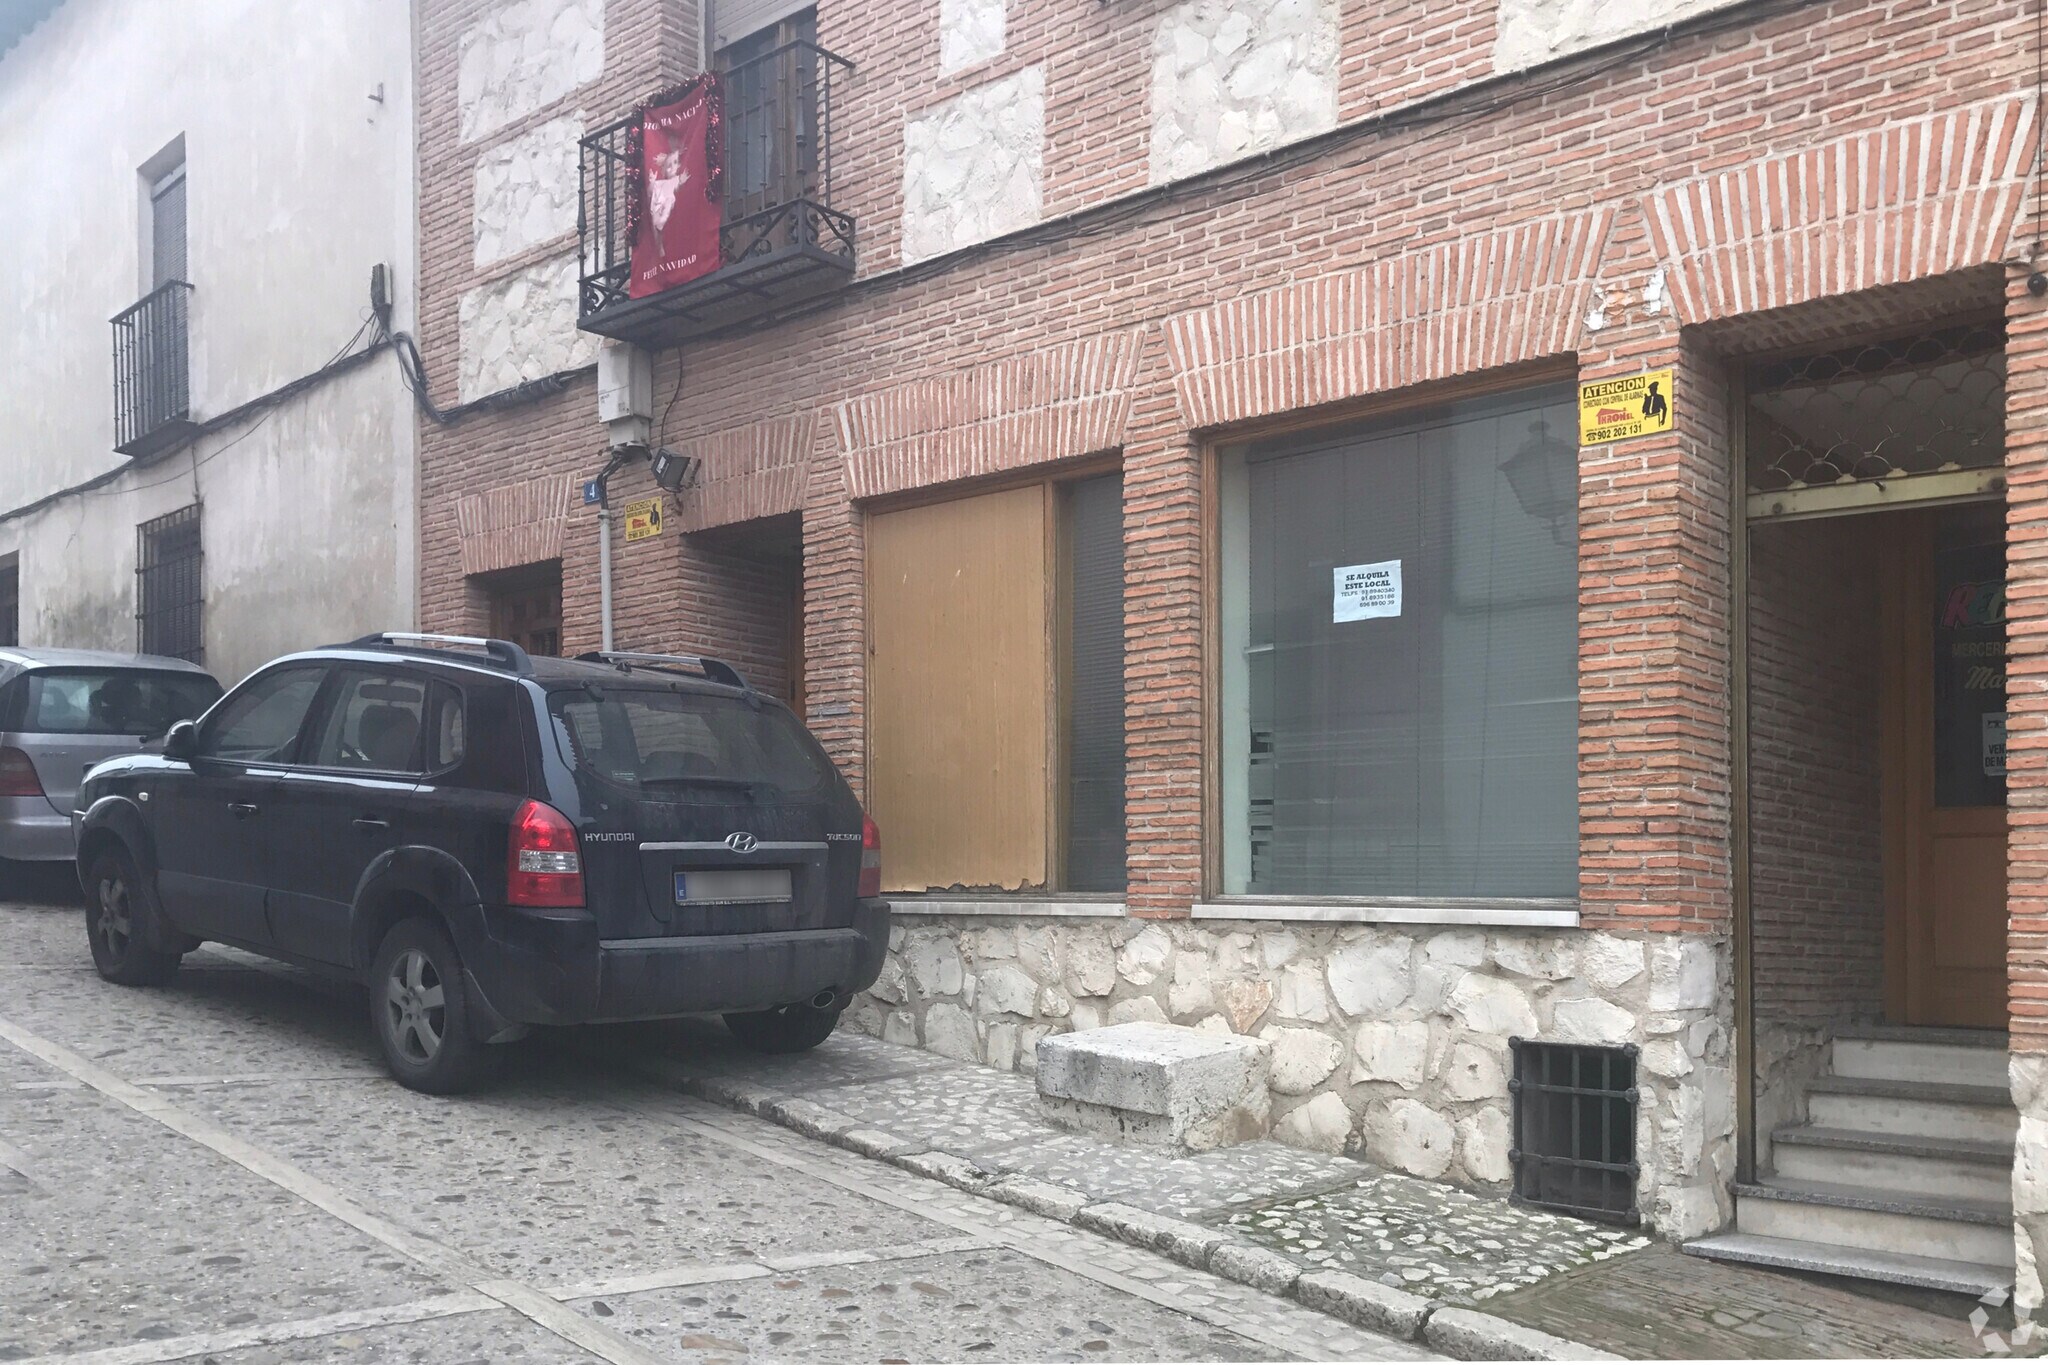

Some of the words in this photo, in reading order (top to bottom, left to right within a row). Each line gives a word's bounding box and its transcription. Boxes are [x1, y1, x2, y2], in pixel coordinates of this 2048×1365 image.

[659, 254, 697, 272] NAVIDAD
[1584, 377, 1644, 399] ATENCION
[1597, 429, 1611, 440] 902
[1613, 426, 1627, 437] 202
[1629, 424, 1642, 434] 131
[589, 483, 595, 498] 4
[1356, 571, 1390, 580] ALQUILA
[1345, 582, 1364, 590] ESTE
[1365, 580, 1391, 588] LOCAL
[584, 832, 635, 842] HYUNDAI
[826, 833, 862, 841] TUCSON
[678, 889, 685, 897] E
